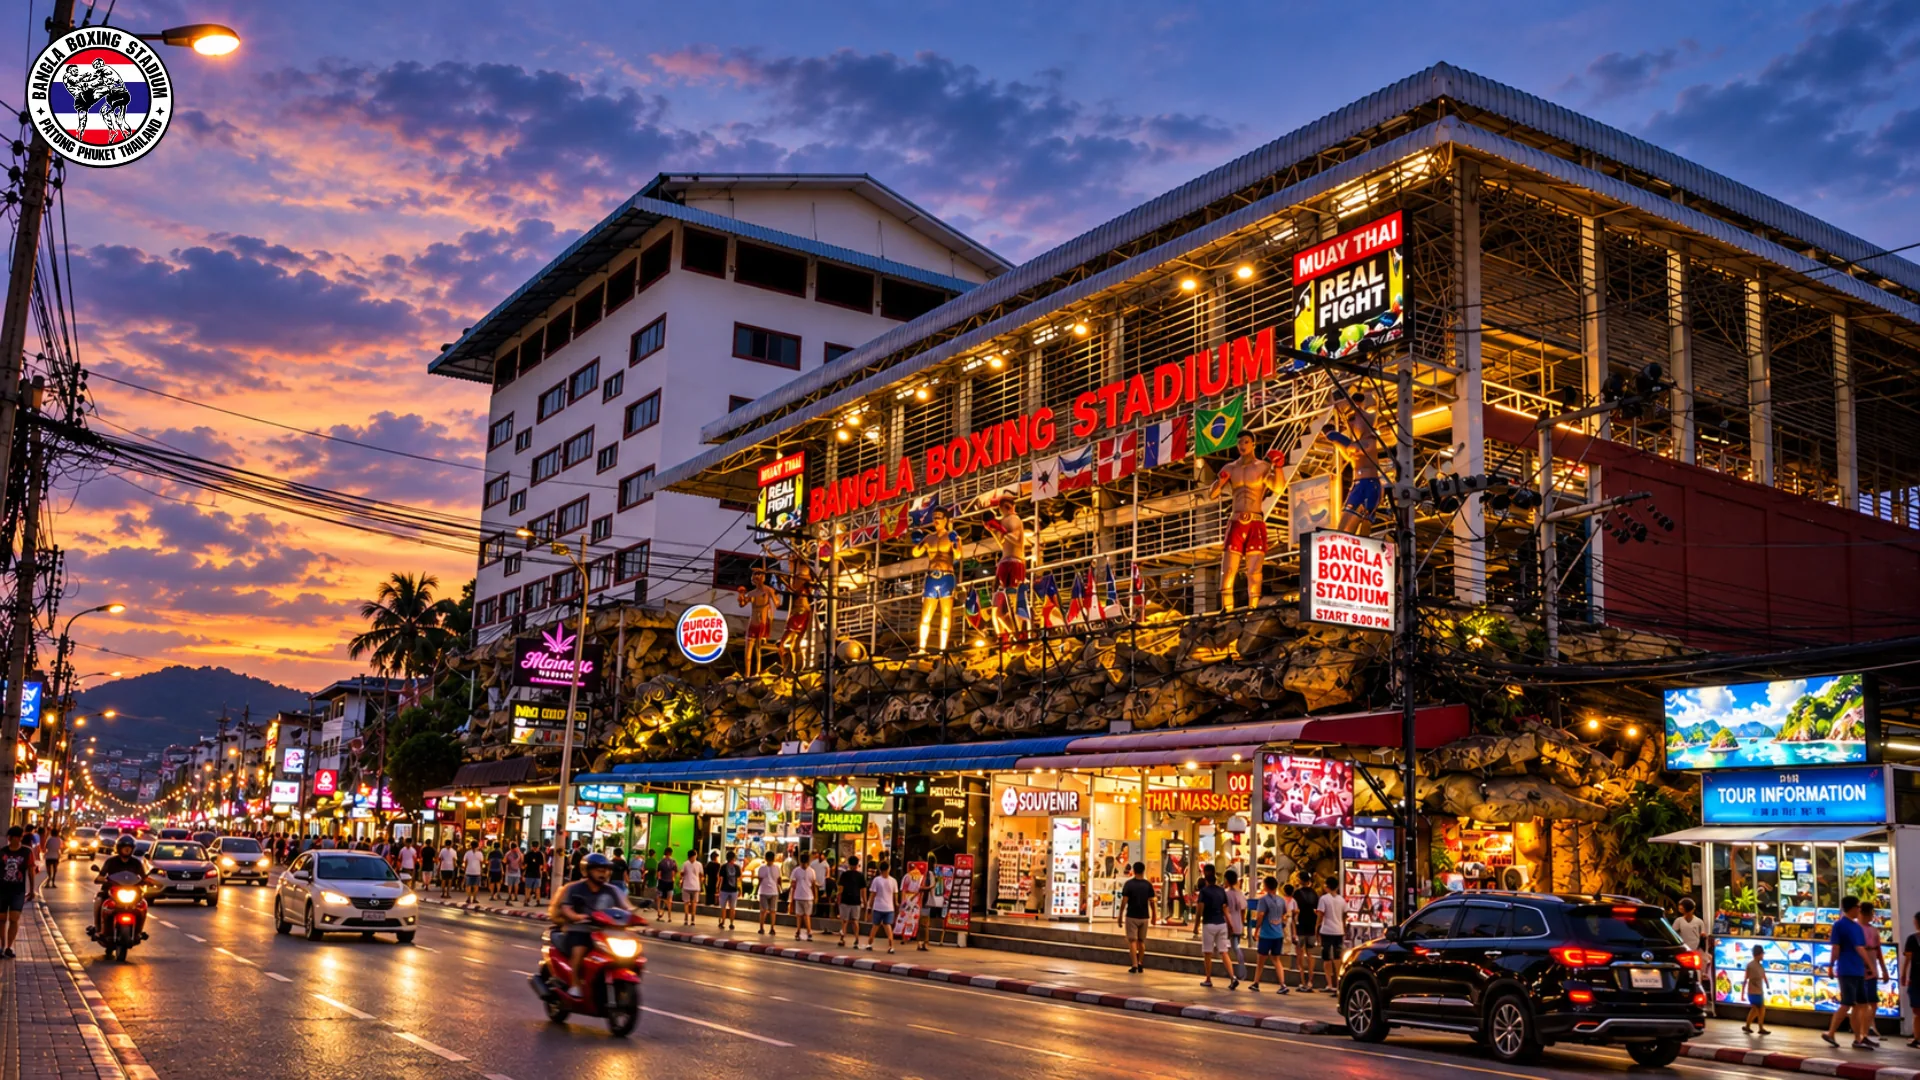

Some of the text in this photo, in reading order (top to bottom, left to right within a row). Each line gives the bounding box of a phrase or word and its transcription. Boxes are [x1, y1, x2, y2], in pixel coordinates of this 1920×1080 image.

[1299, 219, 1397, 277] MUAY THAI
[1319, 259, 1384, 304] REAL
[1319, 282, 1386, 328] FIGHT
[808, 325, 1277, 524] BANGLA BOXING STADIUM
[767, 478, 794, 500] REAL
[767, 493, 795, 515] FIGHT
[1318, 544, 1383, 570] BANGLA
[1318, 562, 1384, 588] BOXING
[1316, 581, 1389, 606] STADIUM
[682, 617, 723, 632] BURGER
[1316, 608, 1390, 628] START 9.00 PM
[683, 629, 723, 648] KING
[1019, 791, 1079, 812] SOUVENIR
[1145, 792, 1249, 812] THAI MASSAGE
[1717, 783, 1867, 804] TOUR INFORMATION
